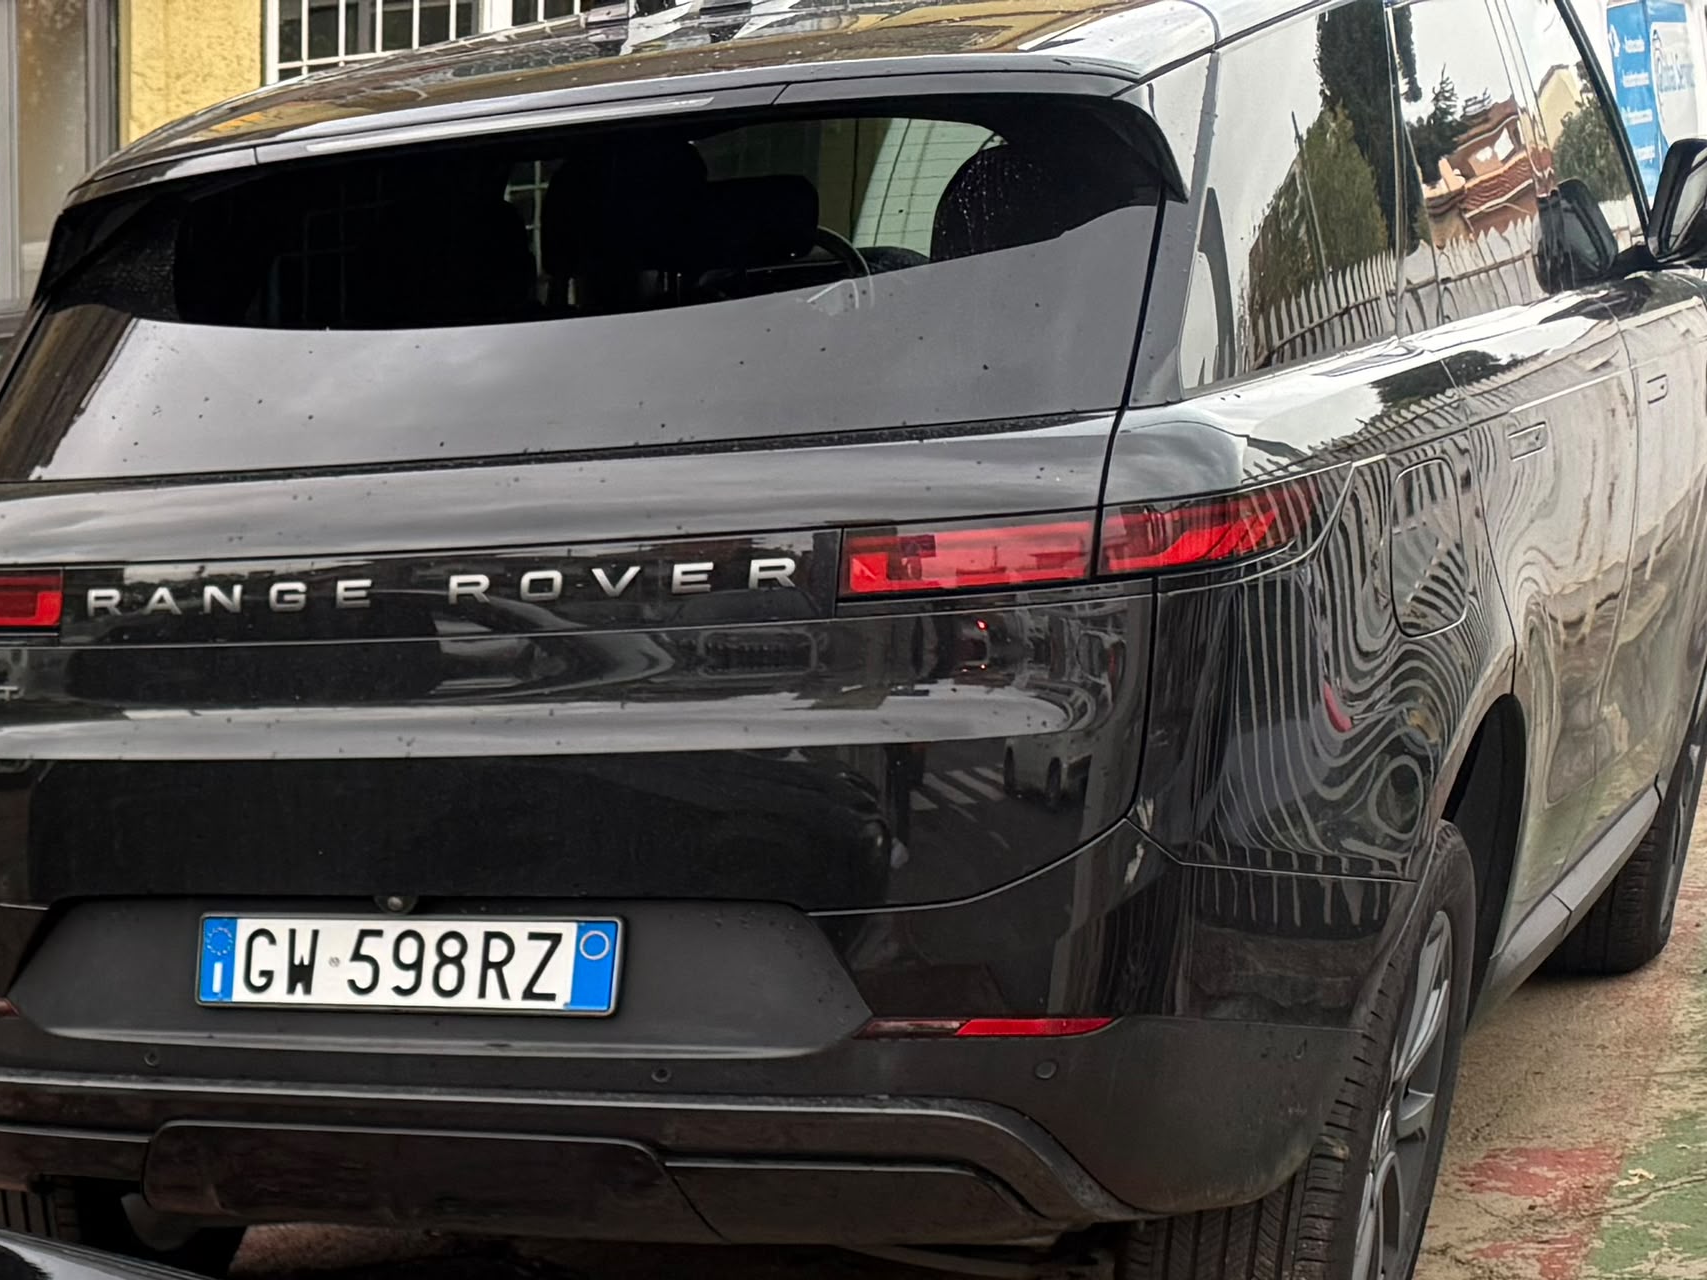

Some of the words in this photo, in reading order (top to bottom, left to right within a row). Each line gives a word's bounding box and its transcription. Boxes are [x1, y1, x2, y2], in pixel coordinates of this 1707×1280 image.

[87, 578, 375, 617] RANGE
[448, 557, 796, 605] ROVER
[243, 926, 321, 996] GW
[346, 928, 564, 1003] 598RZ
